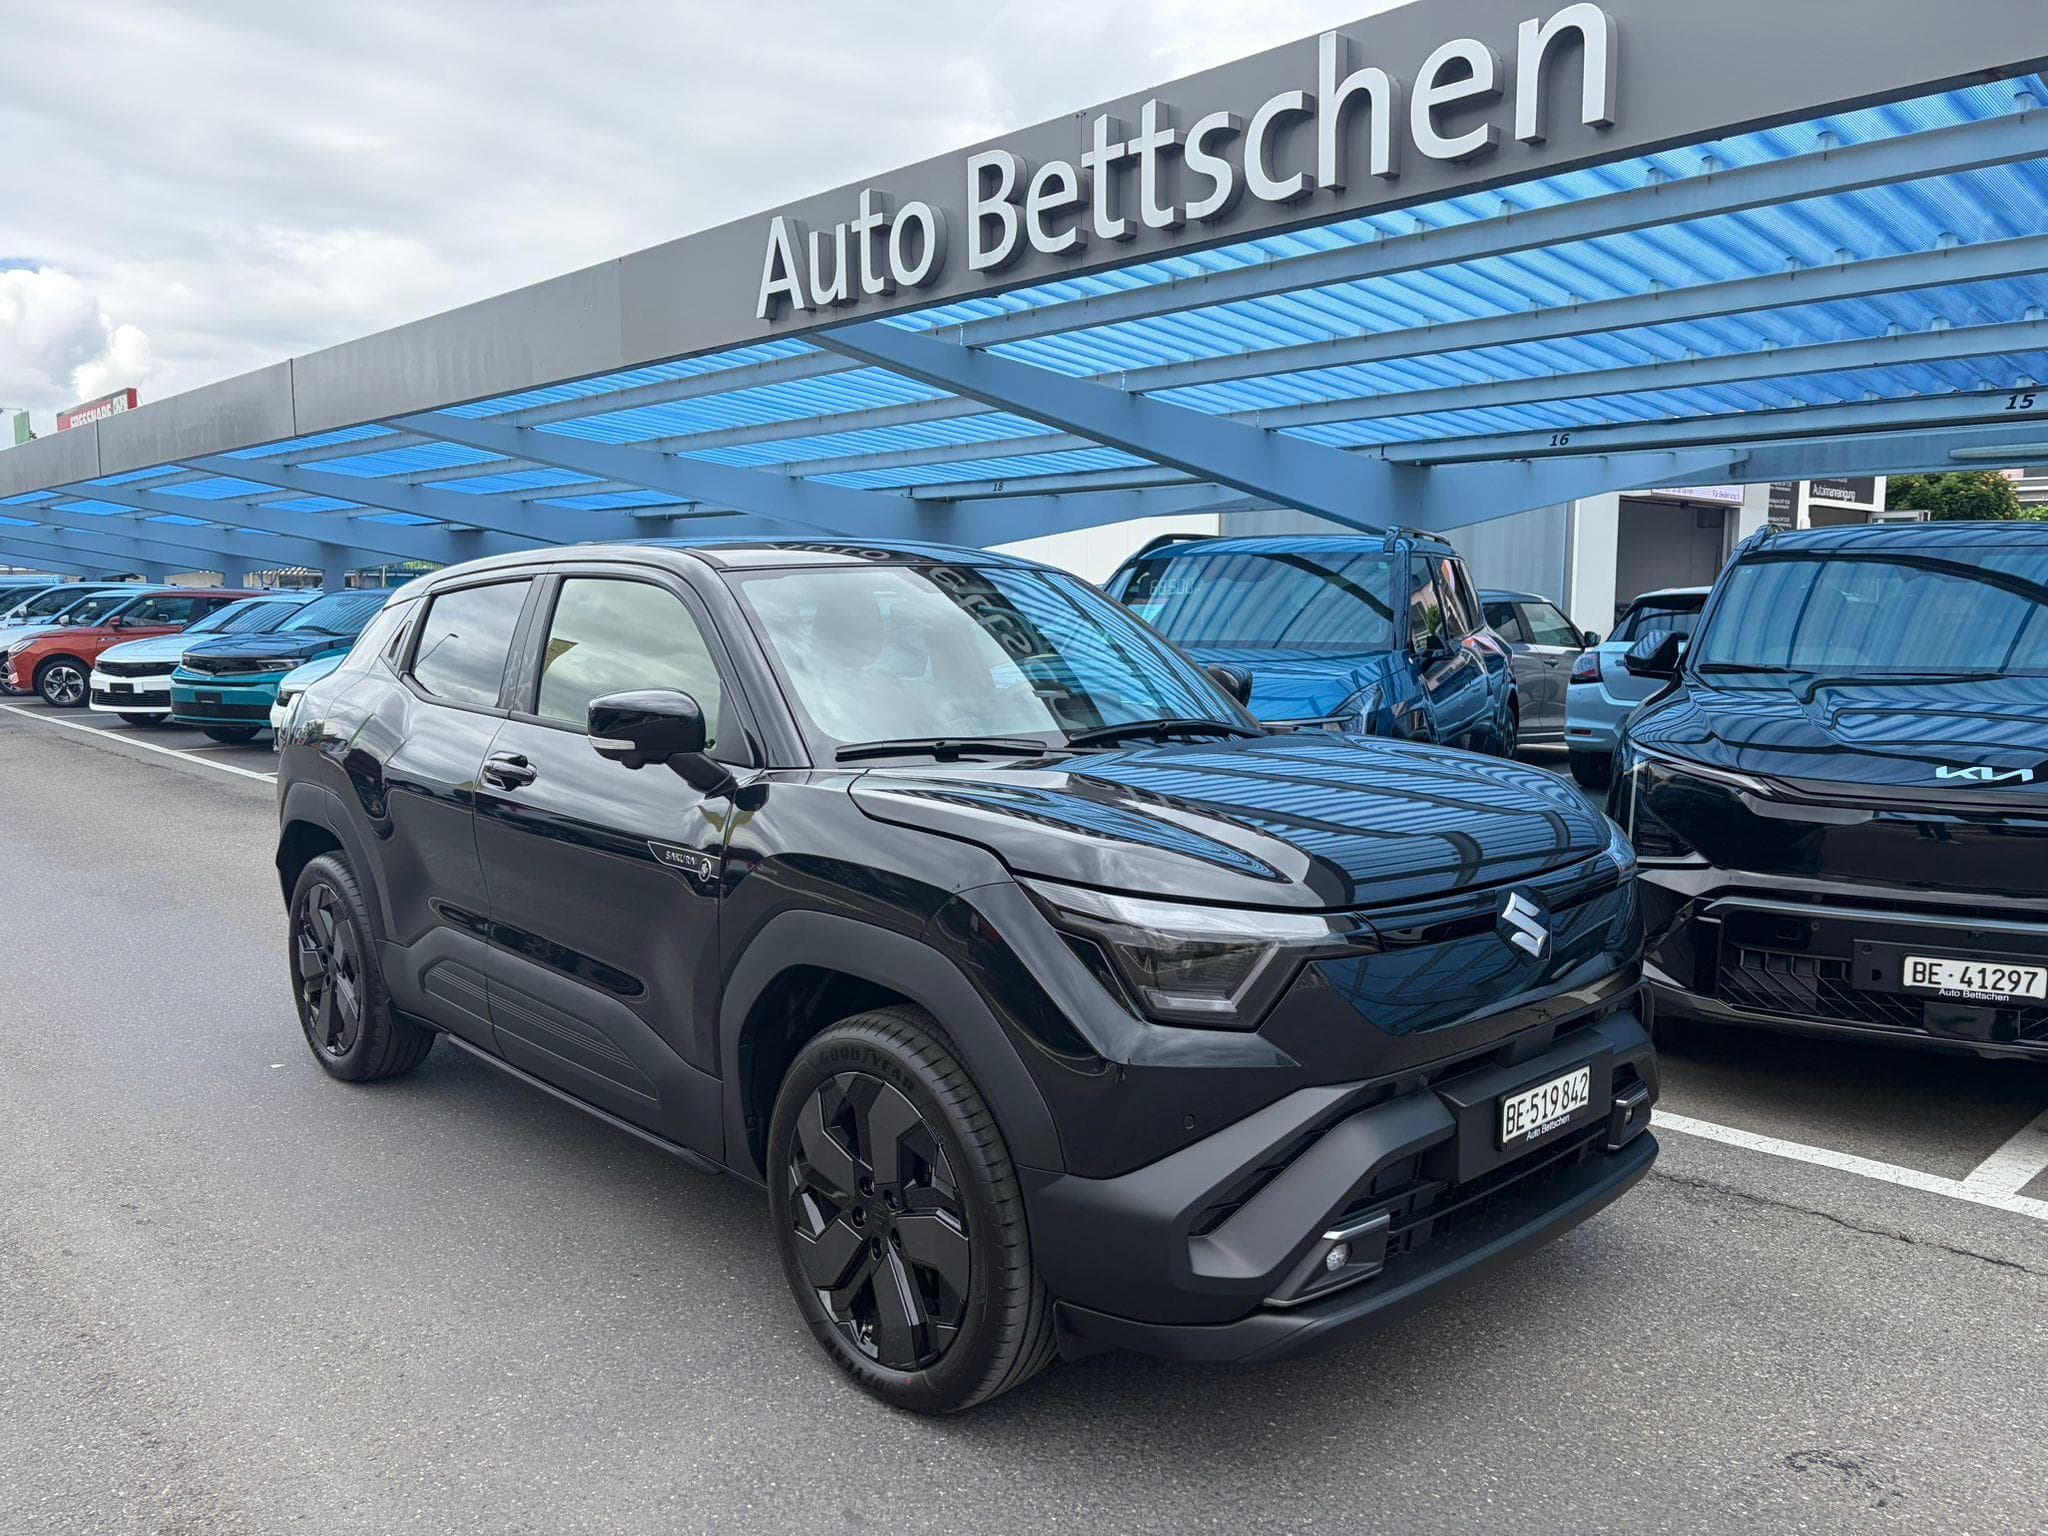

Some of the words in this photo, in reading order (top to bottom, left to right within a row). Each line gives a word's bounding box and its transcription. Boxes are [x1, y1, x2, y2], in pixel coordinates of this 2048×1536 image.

[755, 187, 940, 320] Auto
[967, 3, 1612, 272] Bettschen
[2005, 393, 2037, 410] 15
[1549, 432, 1570, 447] 16
[1938, 988, 1961, 998] Auto
[1962, 989, 2010, 1002] Bettschen
[1525, 1128, 1542, 1142] Auto
[1541, 1114, 1570, 1135] Bettschen
